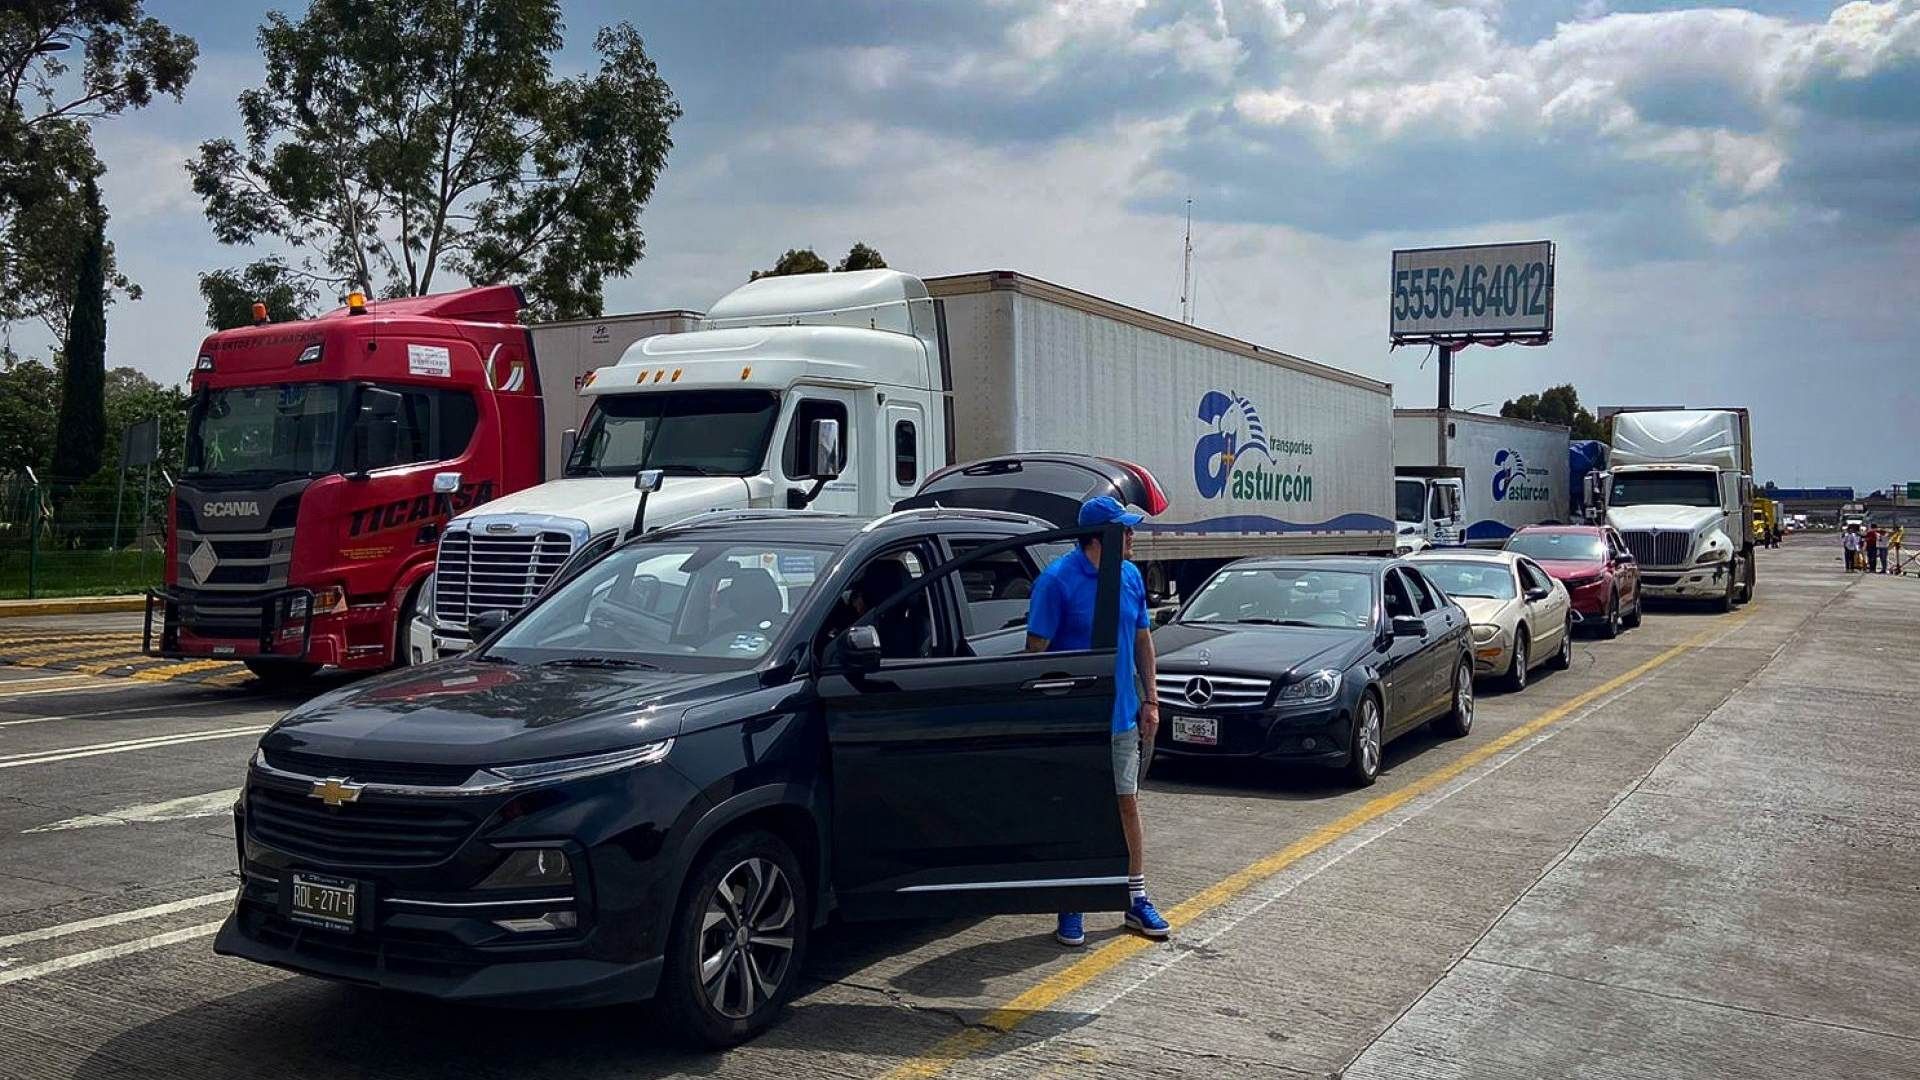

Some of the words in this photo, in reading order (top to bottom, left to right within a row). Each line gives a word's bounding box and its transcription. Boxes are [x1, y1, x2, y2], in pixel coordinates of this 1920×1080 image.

[1394, 261, 1545, 321] 5556464012
[1269, 435, 1313, 456] transportes
[1232, 463, 1312, 502] asturcón
[203, 501, 260, 517] SCANIA
